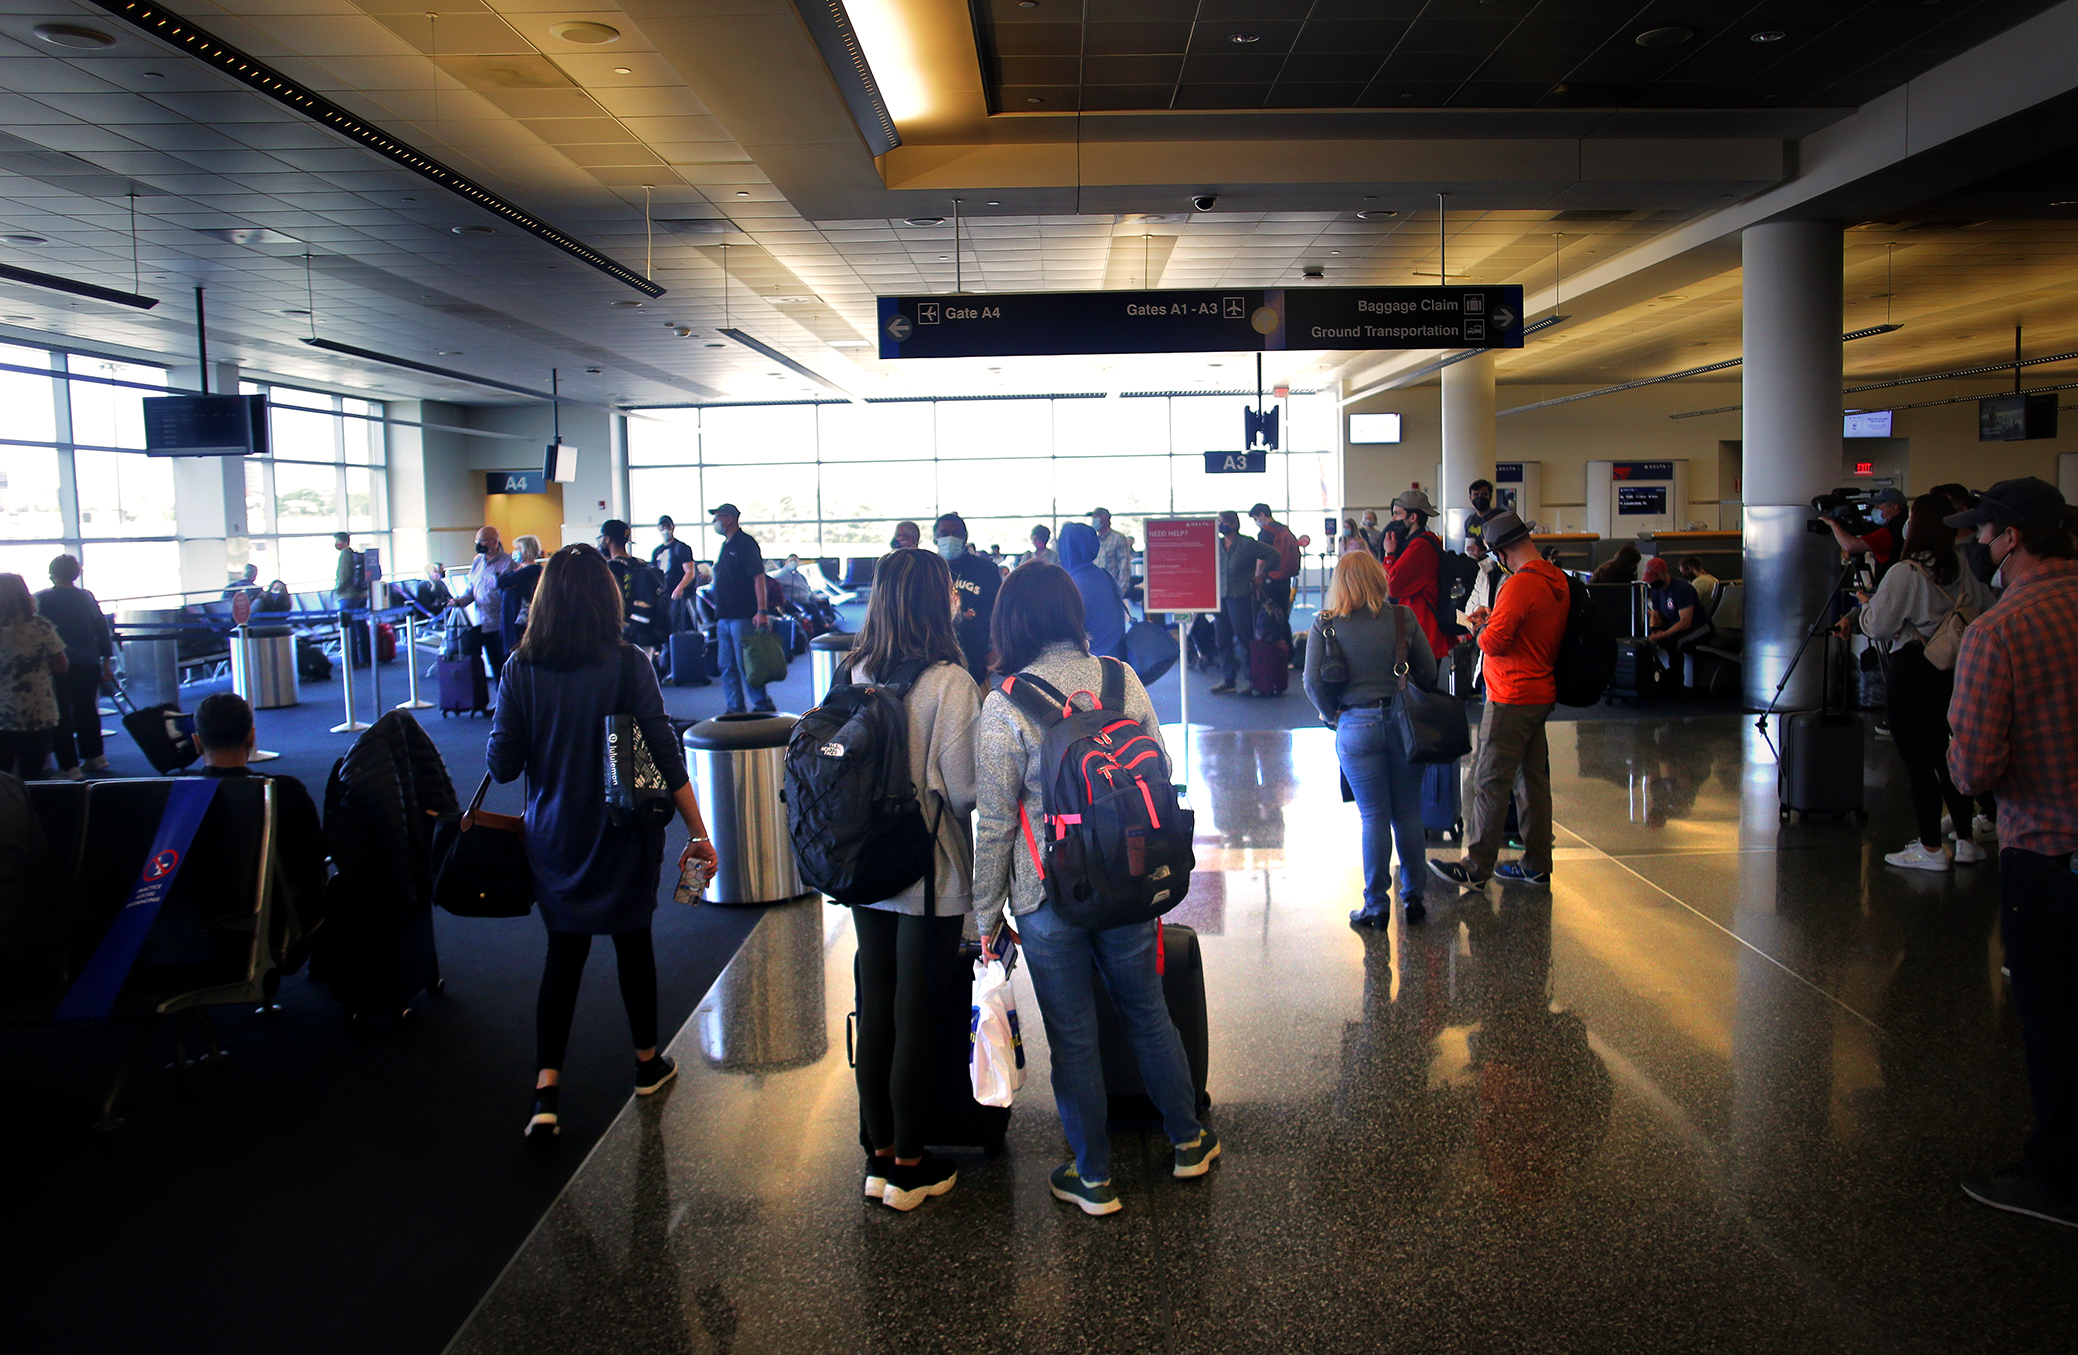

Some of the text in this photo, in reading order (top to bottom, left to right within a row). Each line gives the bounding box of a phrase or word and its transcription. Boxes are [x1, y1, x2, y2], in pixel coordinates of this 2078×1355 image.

[945, 306, 1001, 319] Gate A4
[1126, 303, 1167, 316] Gates
[1357, 299, 1459, 314] Baggage Claim
[1311, 324, 1459, 339] Ground Transportation
[1223, 455, 1247, 470] A3
[1857, 462, 1872, 472] EXIT
[504, 475, 528, 490] A4
[609, 745, 618, 786] lululemon
